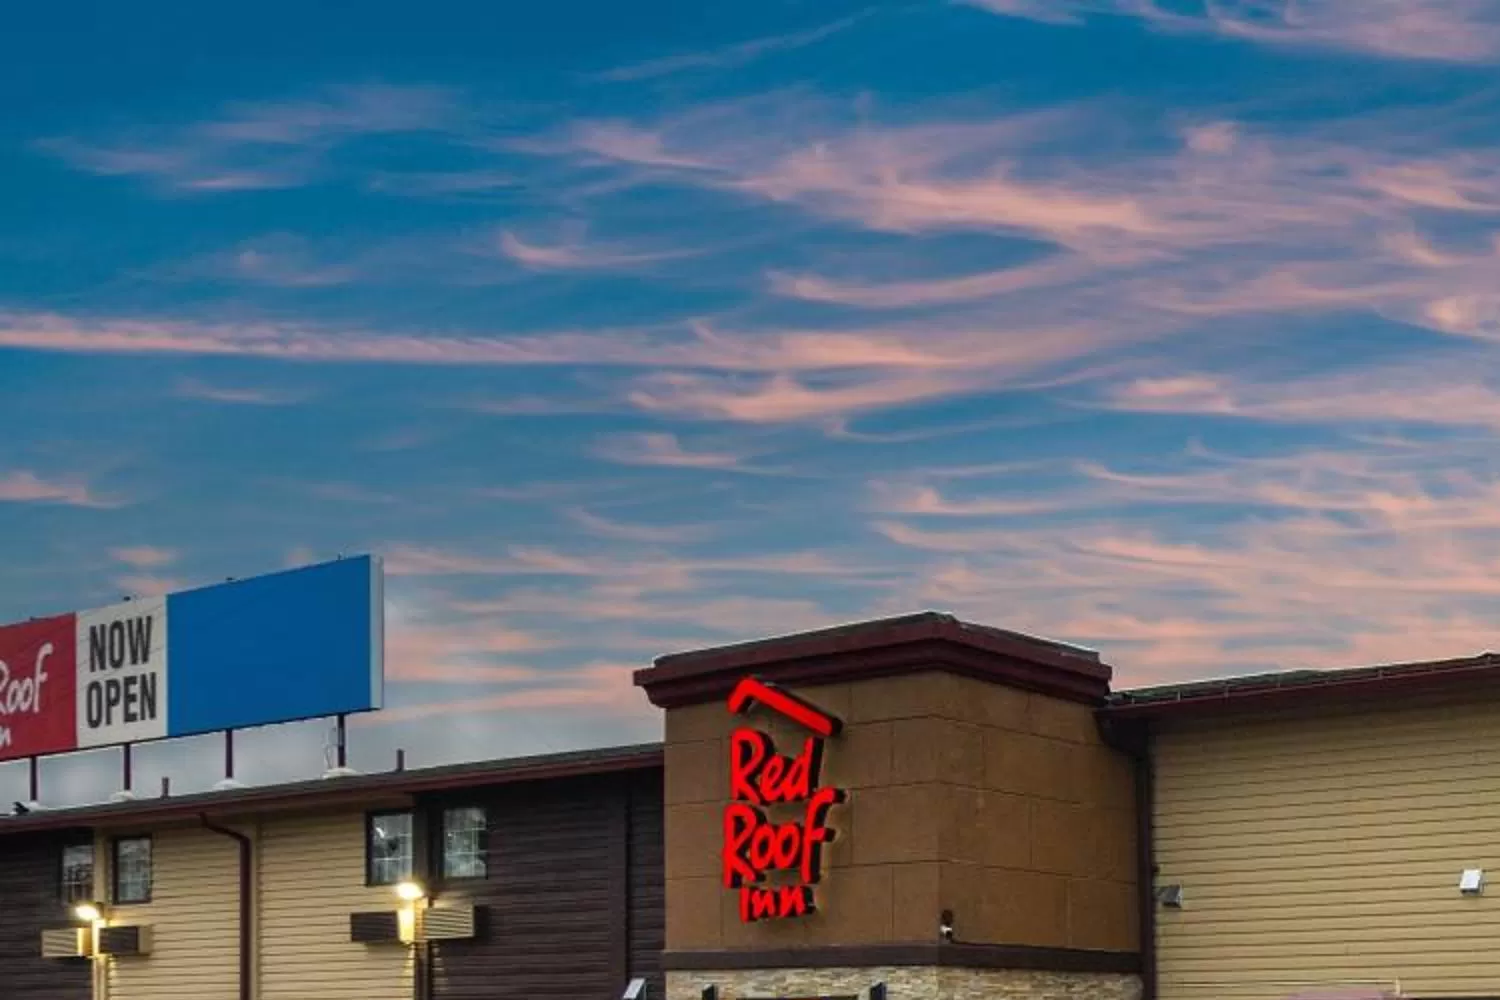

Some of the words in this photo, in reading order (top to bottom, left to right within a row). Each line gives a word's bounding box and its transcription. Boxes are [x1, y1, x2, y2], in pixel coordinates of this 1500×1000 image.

[88, 615, 153, 673] NOW
[86, 671, 157, 729] OPEN
[730, 727, 816, 806] Red
[722, 786, 837, 888] Roof
